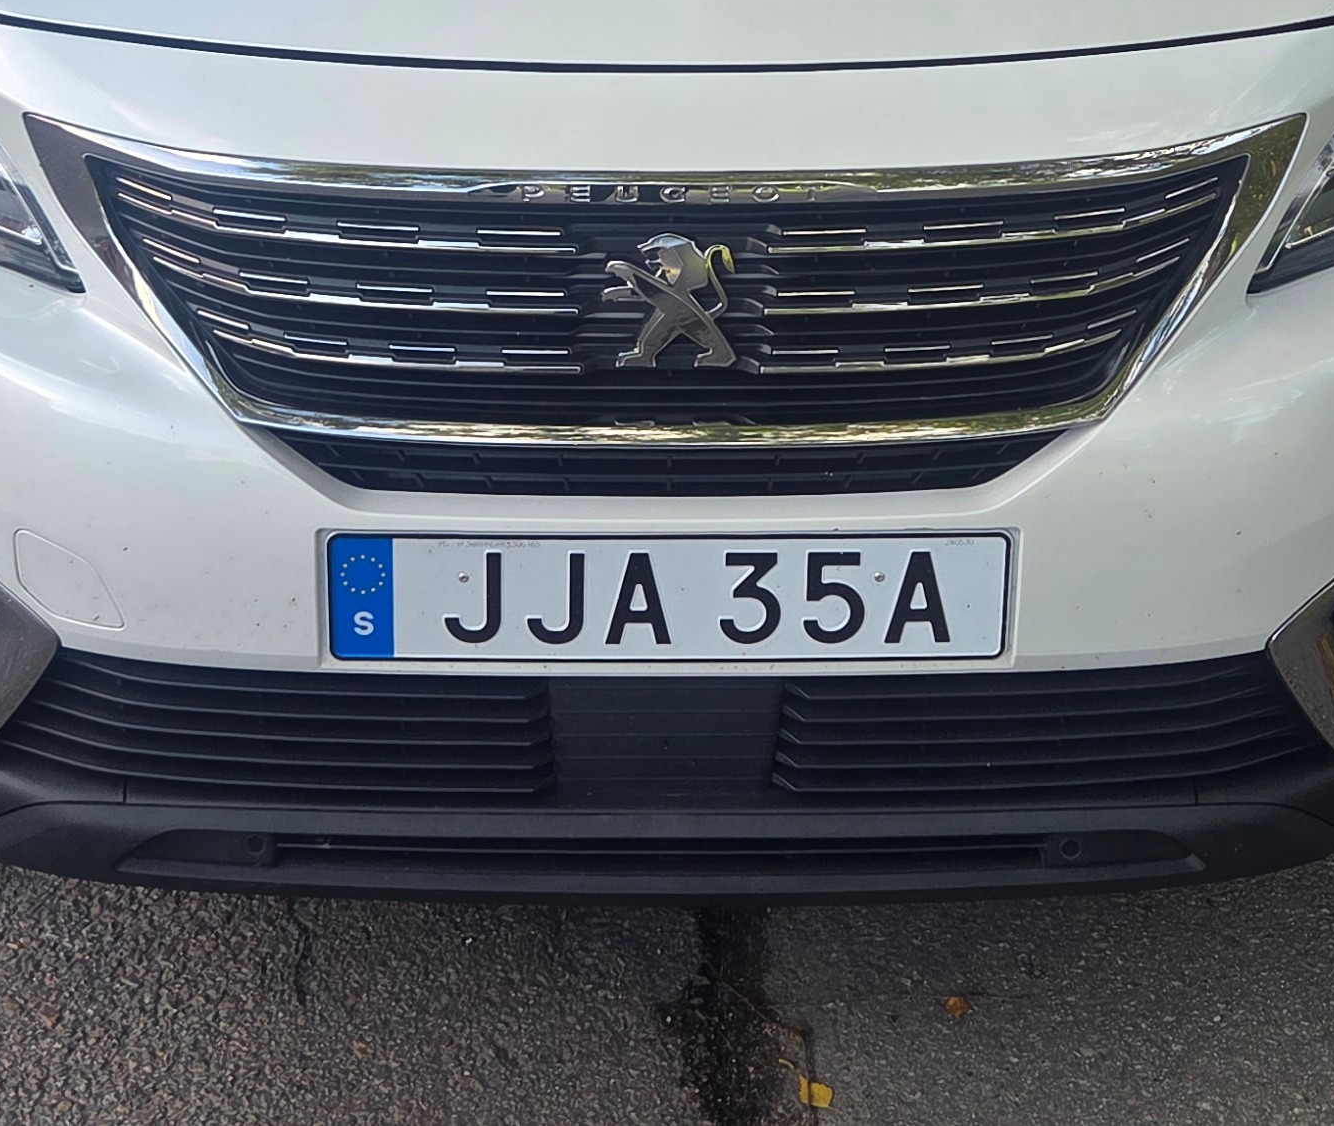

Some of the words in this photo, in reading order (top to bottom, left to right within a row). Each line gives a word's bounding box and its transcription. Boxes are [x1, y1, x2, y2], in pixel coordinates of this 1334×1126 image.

[353, 611, 374, 636] S
[444, 550, 672, 645] JJA
[719, 550, 951, 645] 35A
